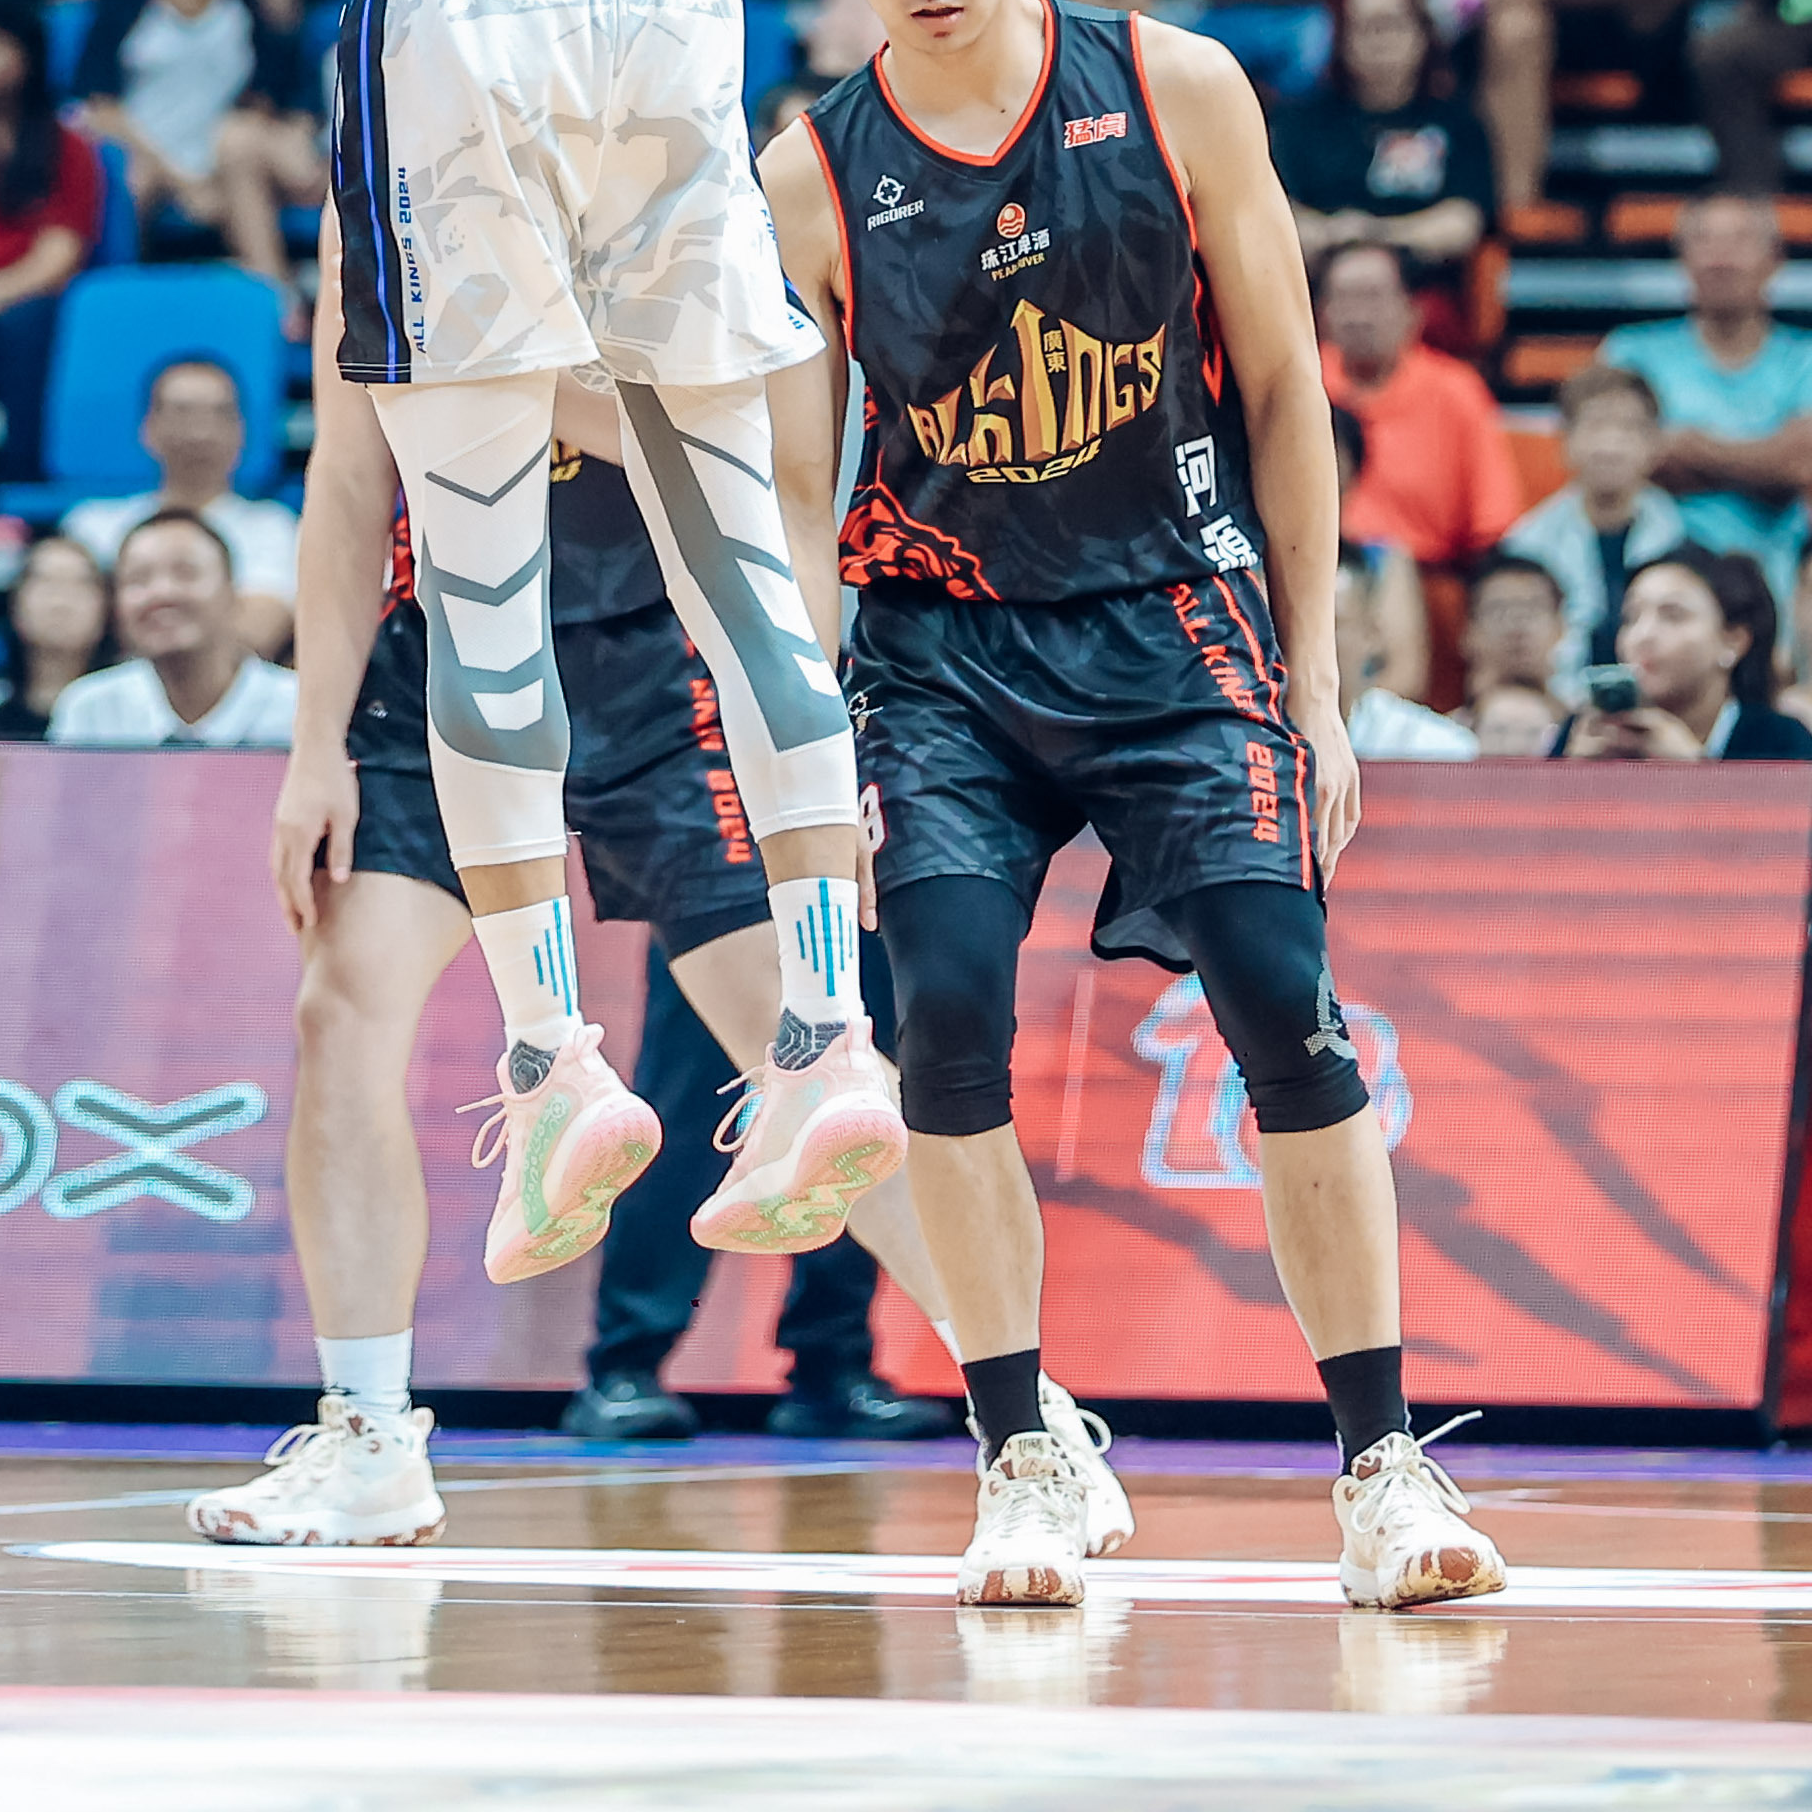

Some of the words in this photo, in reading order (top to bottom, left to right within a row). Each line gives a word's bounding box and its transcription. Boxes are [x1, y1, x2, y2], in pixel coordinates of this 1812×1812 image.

[398, 167, 413, 224] 2024
[866, 200, 925, 232] RIGORER
[401, 236, 424, 303] KINGS
[413, 315, 427, 354] ALL
[1043, 329, 1067, 374] 廣東
[966, 439, 1102, 484] 2024
[1174, 434, 1260, 574] 河源
[1165, 583, 1212, 645] ALL
[1246, 741, 1280, 844] 2024
